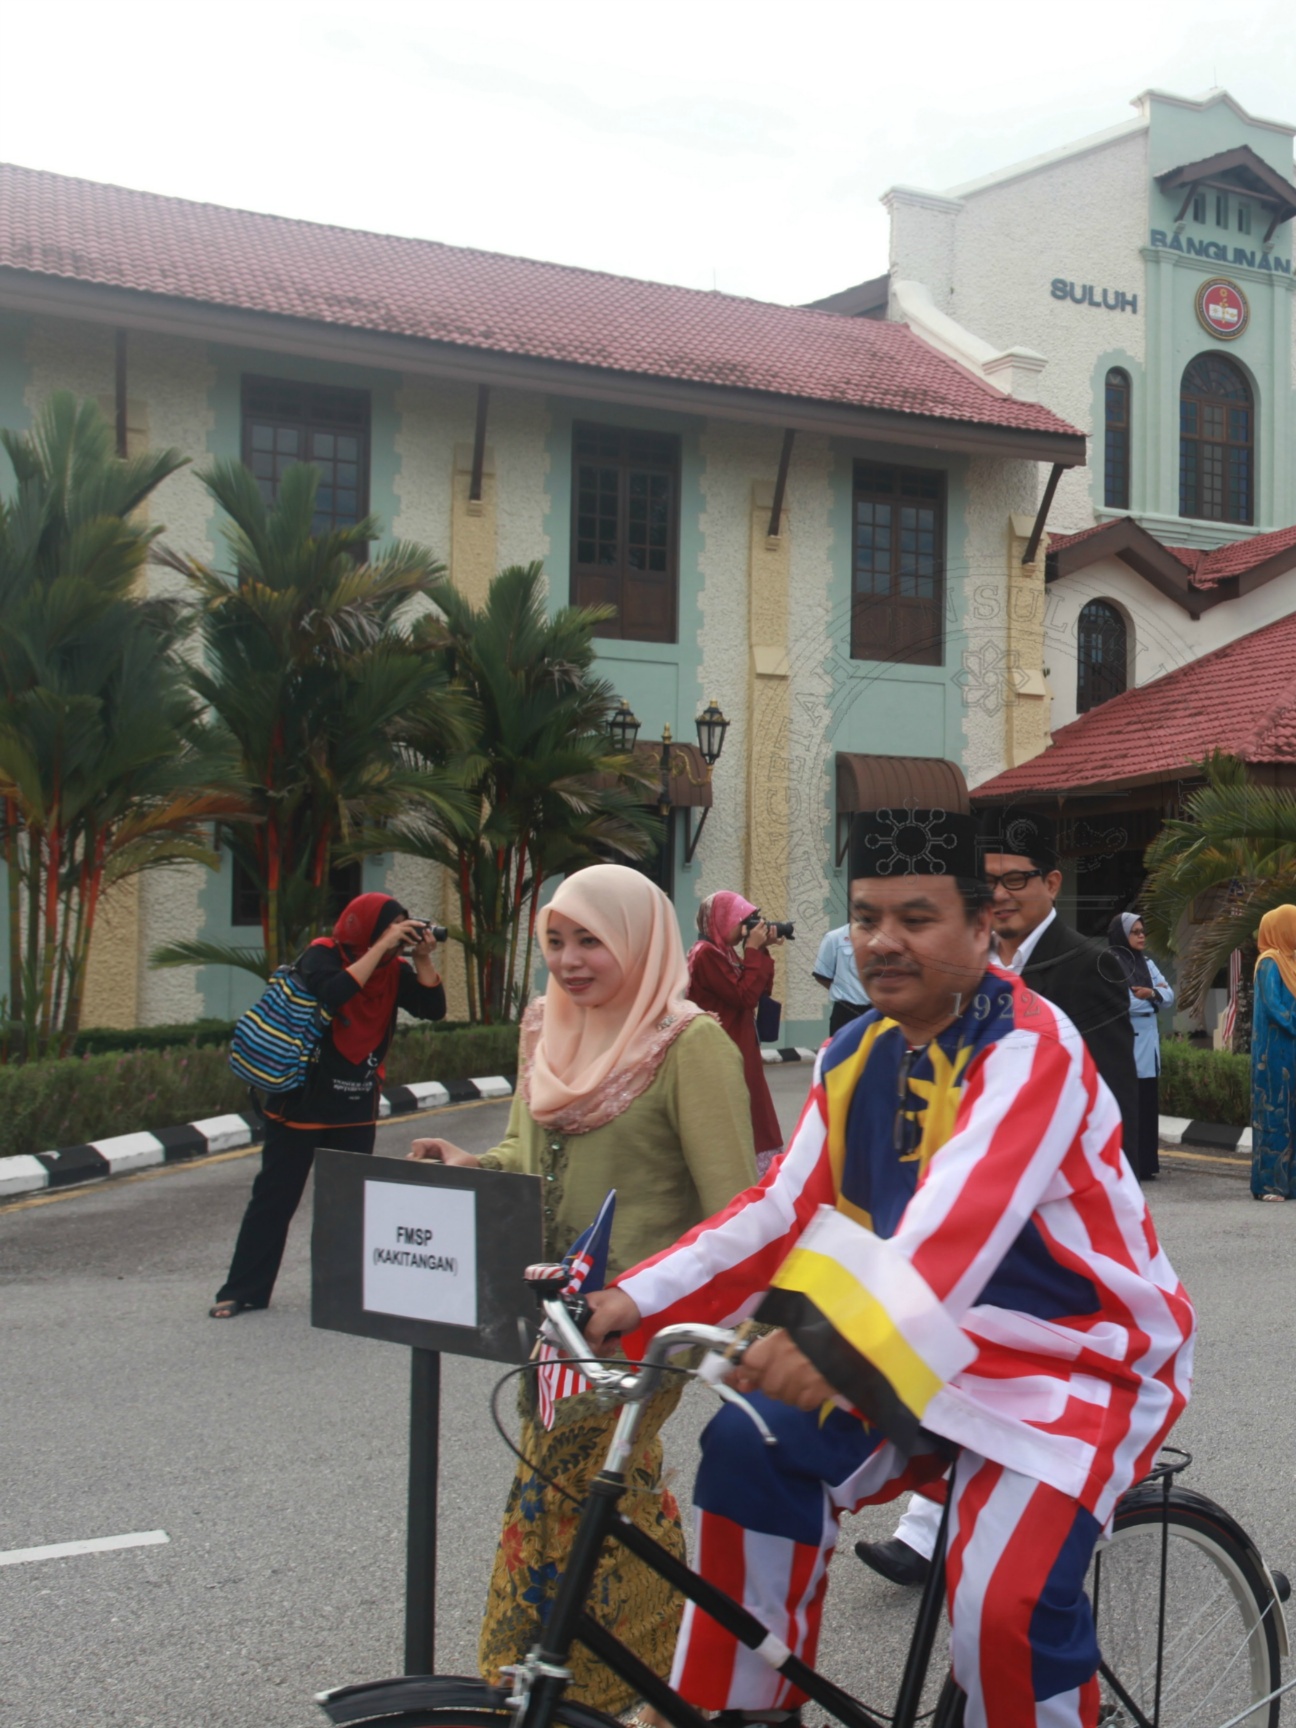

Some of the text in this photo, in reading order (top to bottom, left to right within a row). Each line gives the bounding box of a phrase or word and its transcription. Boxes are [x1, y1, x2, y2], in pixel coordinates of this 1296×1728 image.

[1150, 228, 1292, 276] BANGUNAN
[1050, 278, 1138, 314] SULUH
[395, 1225, 434, 1247] FMSP
[372, 1247, 459, 1277] (KAKITANGAN)
